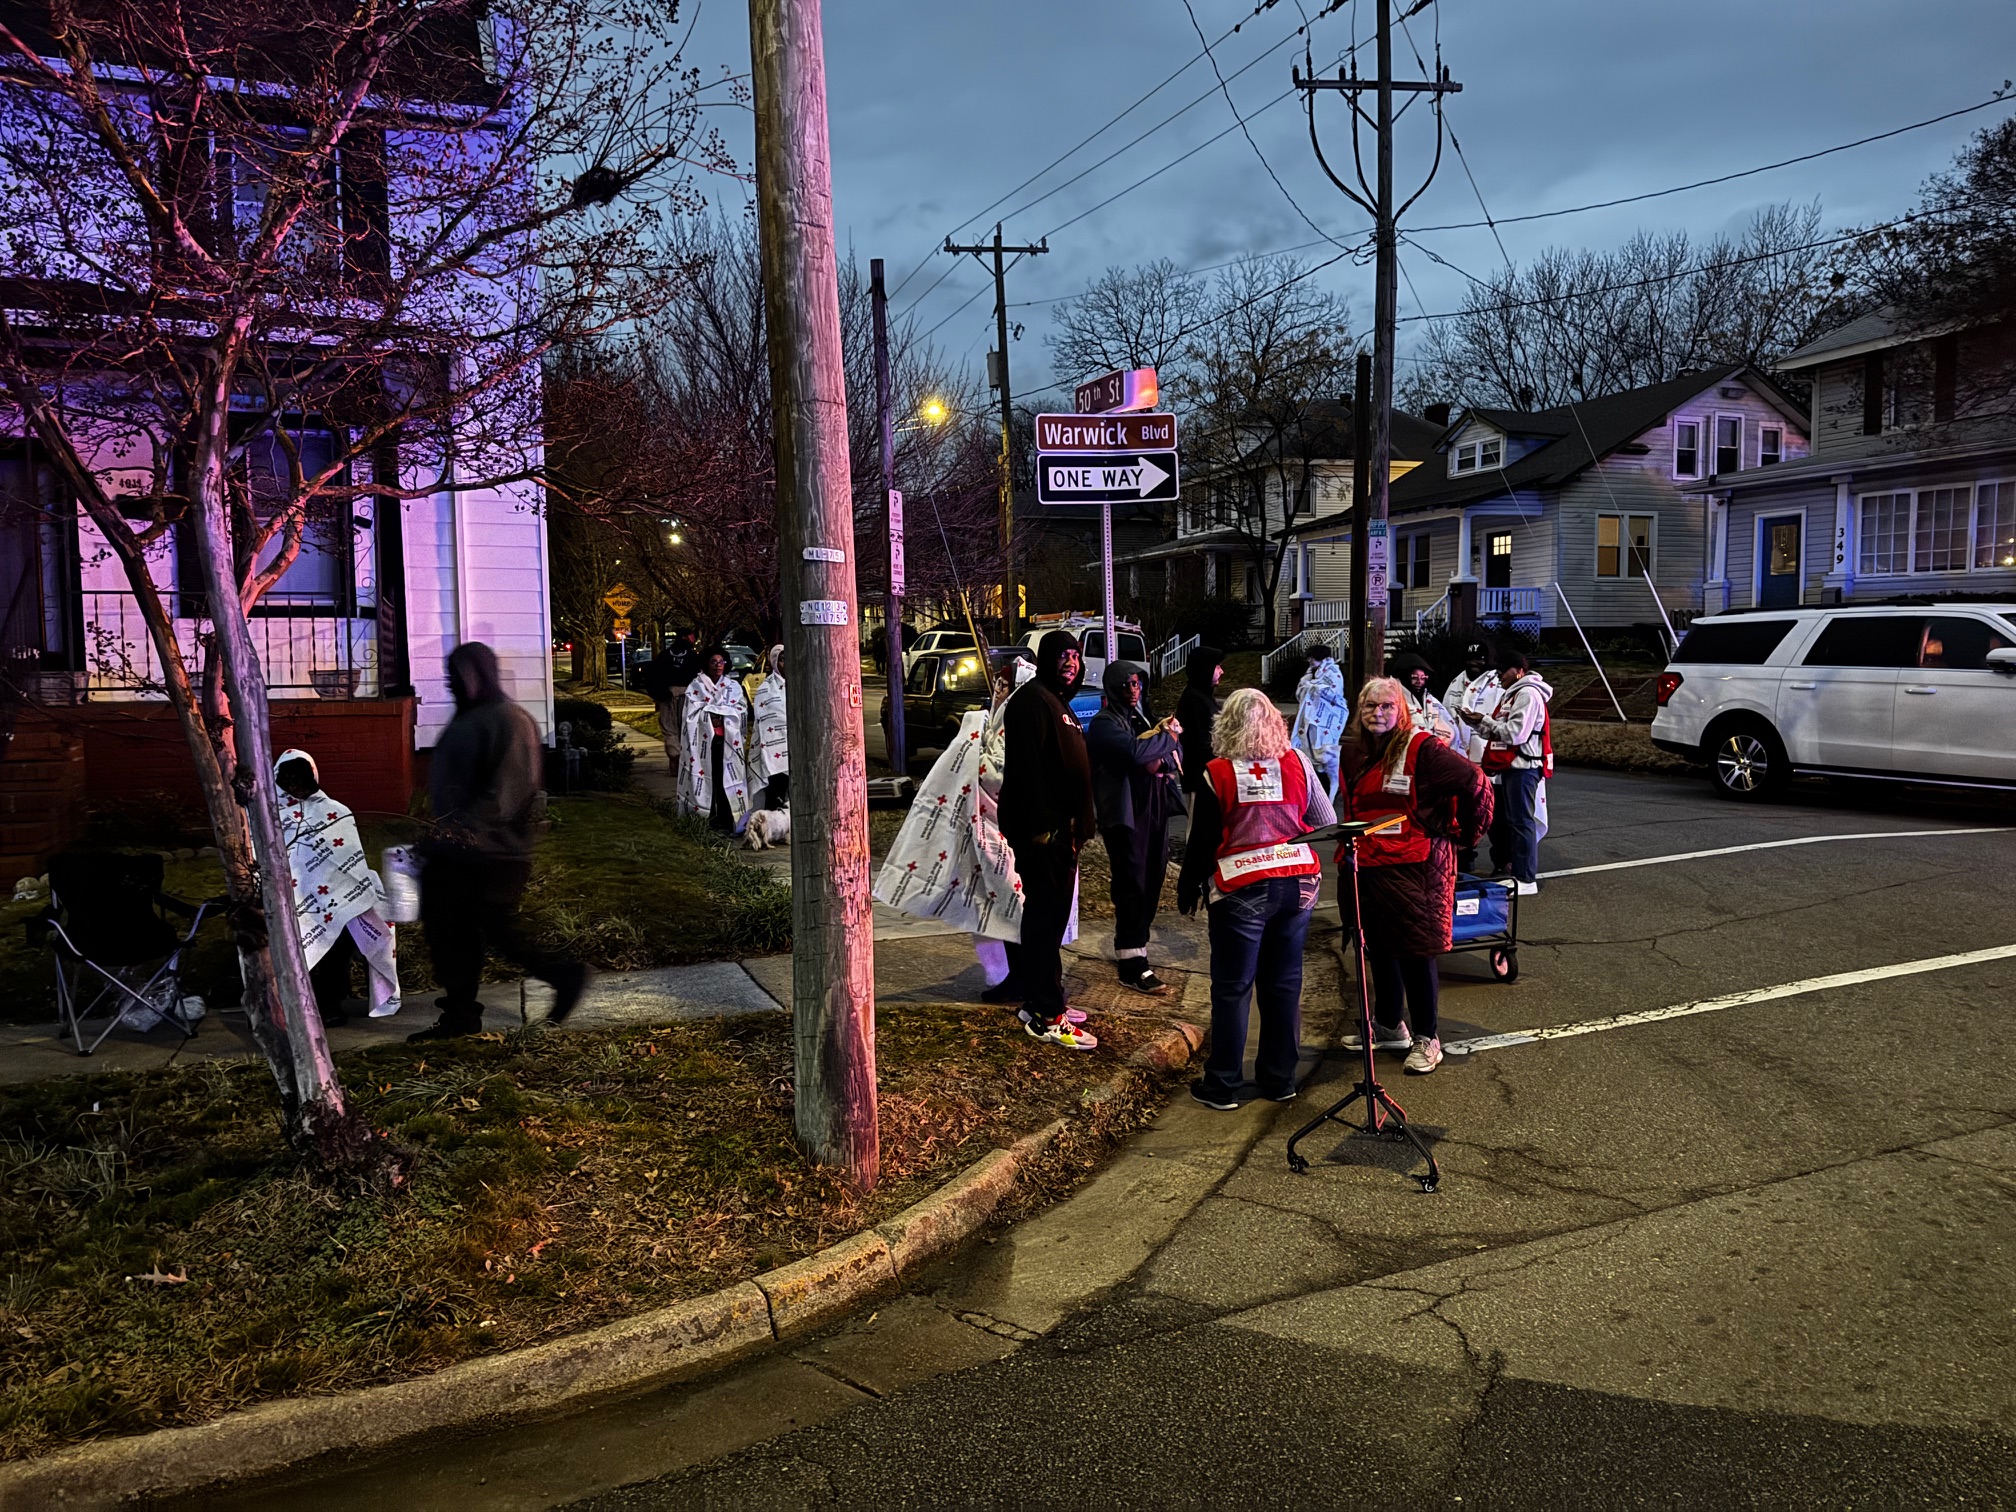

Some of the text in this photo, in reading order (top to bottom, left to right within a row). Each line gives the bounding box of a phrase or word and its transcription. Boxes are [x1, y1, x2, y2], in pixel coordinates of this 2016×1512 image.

[1109, 377, 1120, 403] St
[1044, 421, 1169, 445] Warwick Blvd
[1053, 468, 1144, 487] ONE WAY
[1235, 853, 1275, 868] Disaster
[302, 927, 327, 949] America
